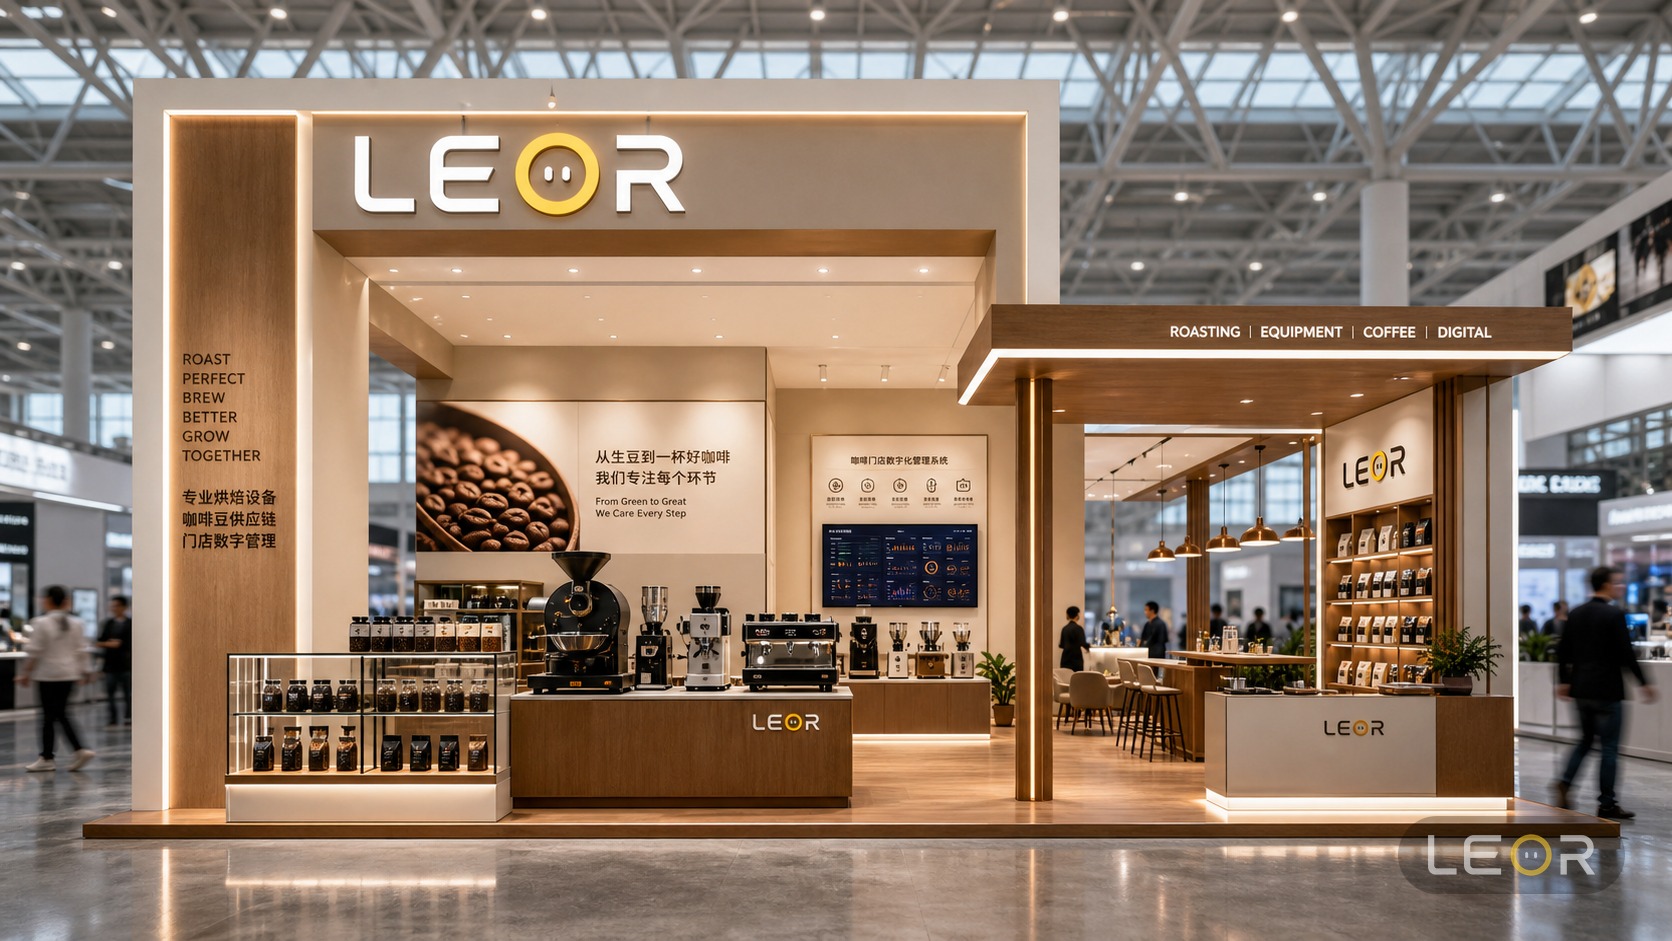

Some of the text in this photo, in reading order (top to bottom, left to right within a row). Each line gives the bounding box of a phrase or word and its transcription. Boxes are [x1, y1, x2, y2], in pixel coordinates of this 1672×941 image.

[354, 132, 686, 215] LEOR
[1170, 325, 1493, 340] ROASTING EQUIPMENT COFFEE DIGITAL
[182, 353, 231, 366] ROAST
[182, 372, 246, 386] PERFECT
[182, 391, 226, 404] BREW
[182, 410, 238, 424] BETTER
[182, 430, 230, 443] GROW
[182, 449, 261, 463] TOGETHER
[595, 448, 731, 466] 从生豆到一杯好咖啡
[1342, 445, 1406, 489] LEOR
[595, 469, 717, 486] 我们专注每个环节
[182, 488, 277, 506] 专业烘焙设备
[595, 496, 687, 506] From Green to Great
[182, 510, 277, 528] 咖啡豆供应链
[595, 508, 687, 520] We Care Every Step
[182, 532, 277, 550] 门店数字管理
[753, 713, 820, 731] LEOR
[1324, 720, 1384, 736] LEOR
